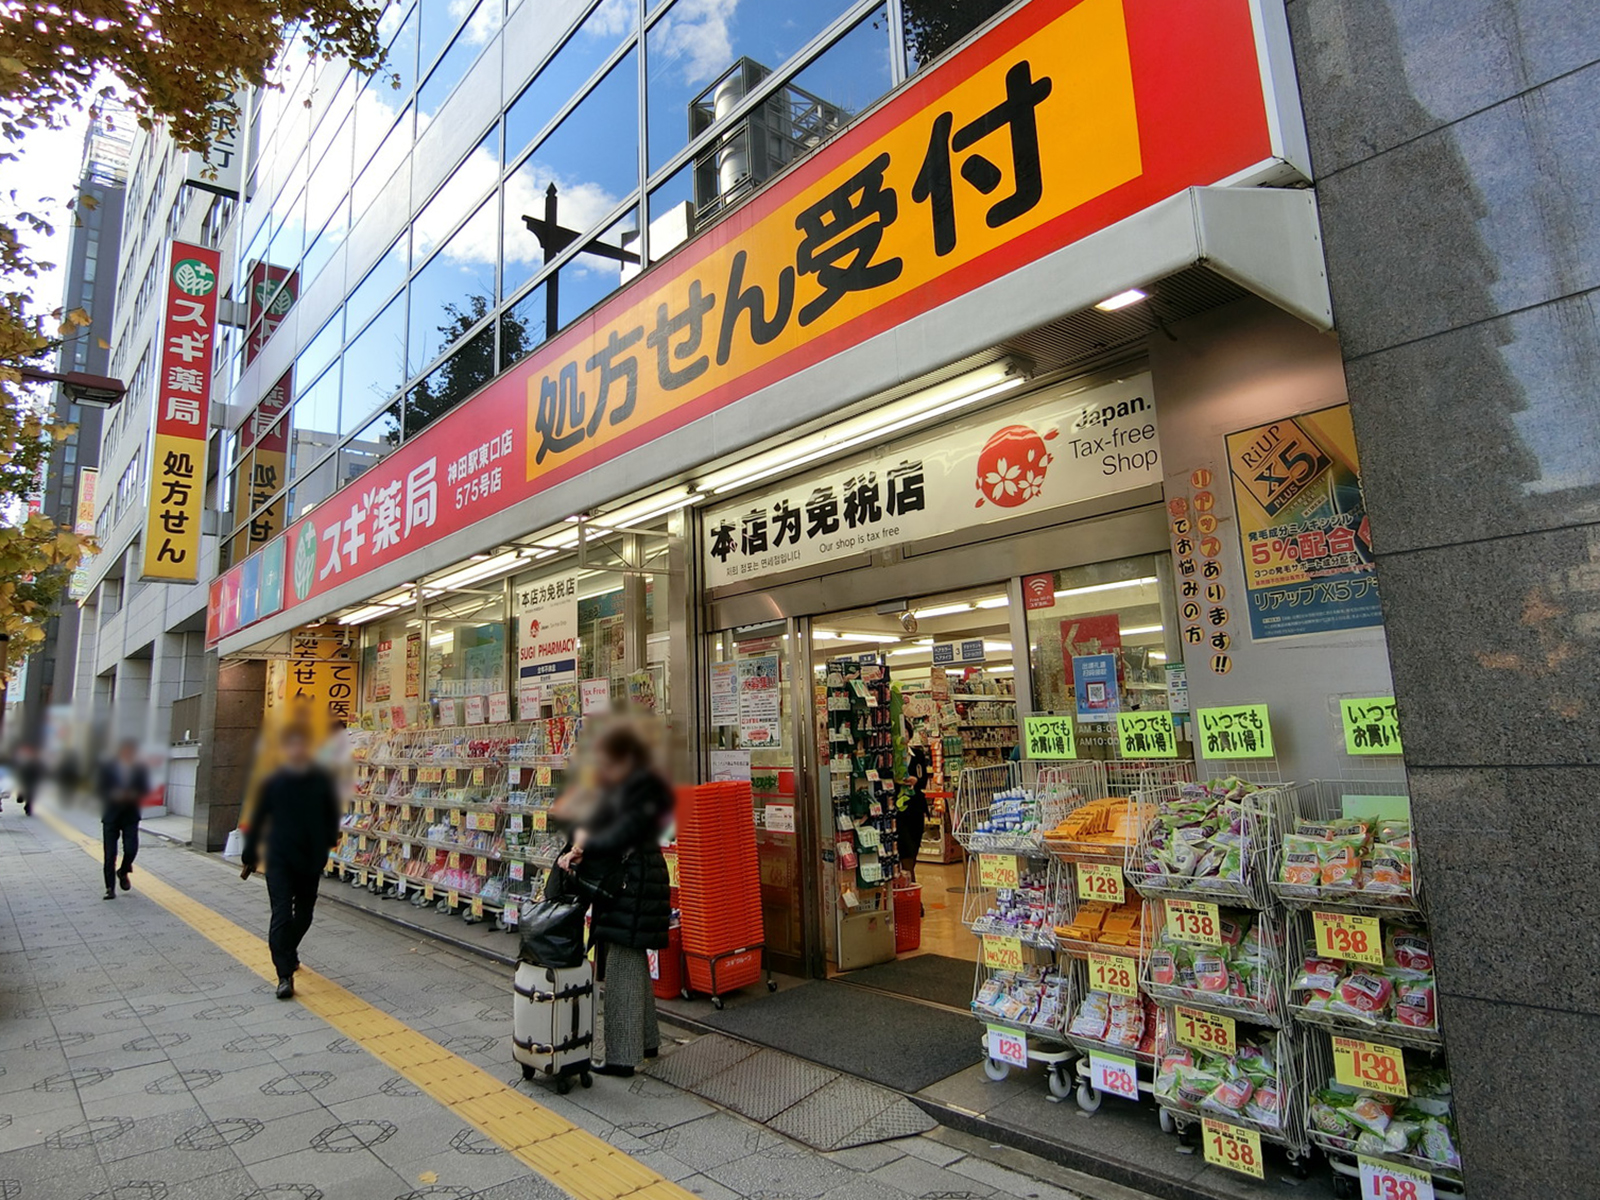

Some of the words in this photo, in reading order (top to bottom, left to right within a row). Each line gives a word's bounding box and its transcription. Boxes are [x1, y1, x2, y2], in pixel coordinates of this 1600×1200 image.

[535, 60, 1051, 465] 処方せん受付
[165, 299, 210, 425] スギ薬局
[1076, 395, 1152, 430] Japan.
[1069, 421, 1156, 459] Tax-free
[1241, 425, 1280, 468] RiUP
[447, 428, 514, 486] 神田駅東口店
[1102, 446, 1158, 478] Shop
[1254, 440, 1316, 497] X5
[455, 467, 503, 510] 575号店
[1273, 484, 1298, 508] PLUS
[157, 451, 194, 563] 処方せん
[319, 456, 438, 581] スギ薬局
[709, 459, 926, 563] 本店为免税店
[819, 543, 833, 554] Our
[836, 536, 856, 552] shop
[857, 533, 865, 543] is
[866, 531, 881, 542] tax
[882, 526, 900, 538] free
[1248, 513, 1353, 542] 発毛成分ミノキシジル
[1252, 526, 1356, 565] 5%配合
[1169, 498, 1203, 642] でお悩みの方
[1254, 554, 1359, 578] 3つの発毛サポート成分配合
[522, 577, 575, 607] 本店为免税店
[521, 646, 535, 660] SUGI
[538, 637, 576, 657] PHARMACY
[593, 687, 606, 695] Free
[1028, 720, 1070, 736] いつでも
[1121, 714, 1172, 733] いつでも
[1203, 709, 1263, 732] いつでも
[1031, 736, 1071, 754] お買い得!
[1125, 733, 1174, 753] お買い得!
[1207, 730, 1264, 752] お買い得!
[1352, 723, 1401, 748] お買い
[1085, 875, 1118, 894] 128
[1175, 914, 1214, 936] 138
[1326, 926, 1368, 953] 138
[1097, 965, 1130, 987] 128
[1185, 1021, 1227, 1045] 138
[999, 1039, 1022, 1060] 128
[1103, 1069, 1132, 1092] 128
[1353, 1050, 1399, 1085] 138
[1213, 1136, 1254, 1165] 138
[1373, 1174, 1417, 1200] 138
